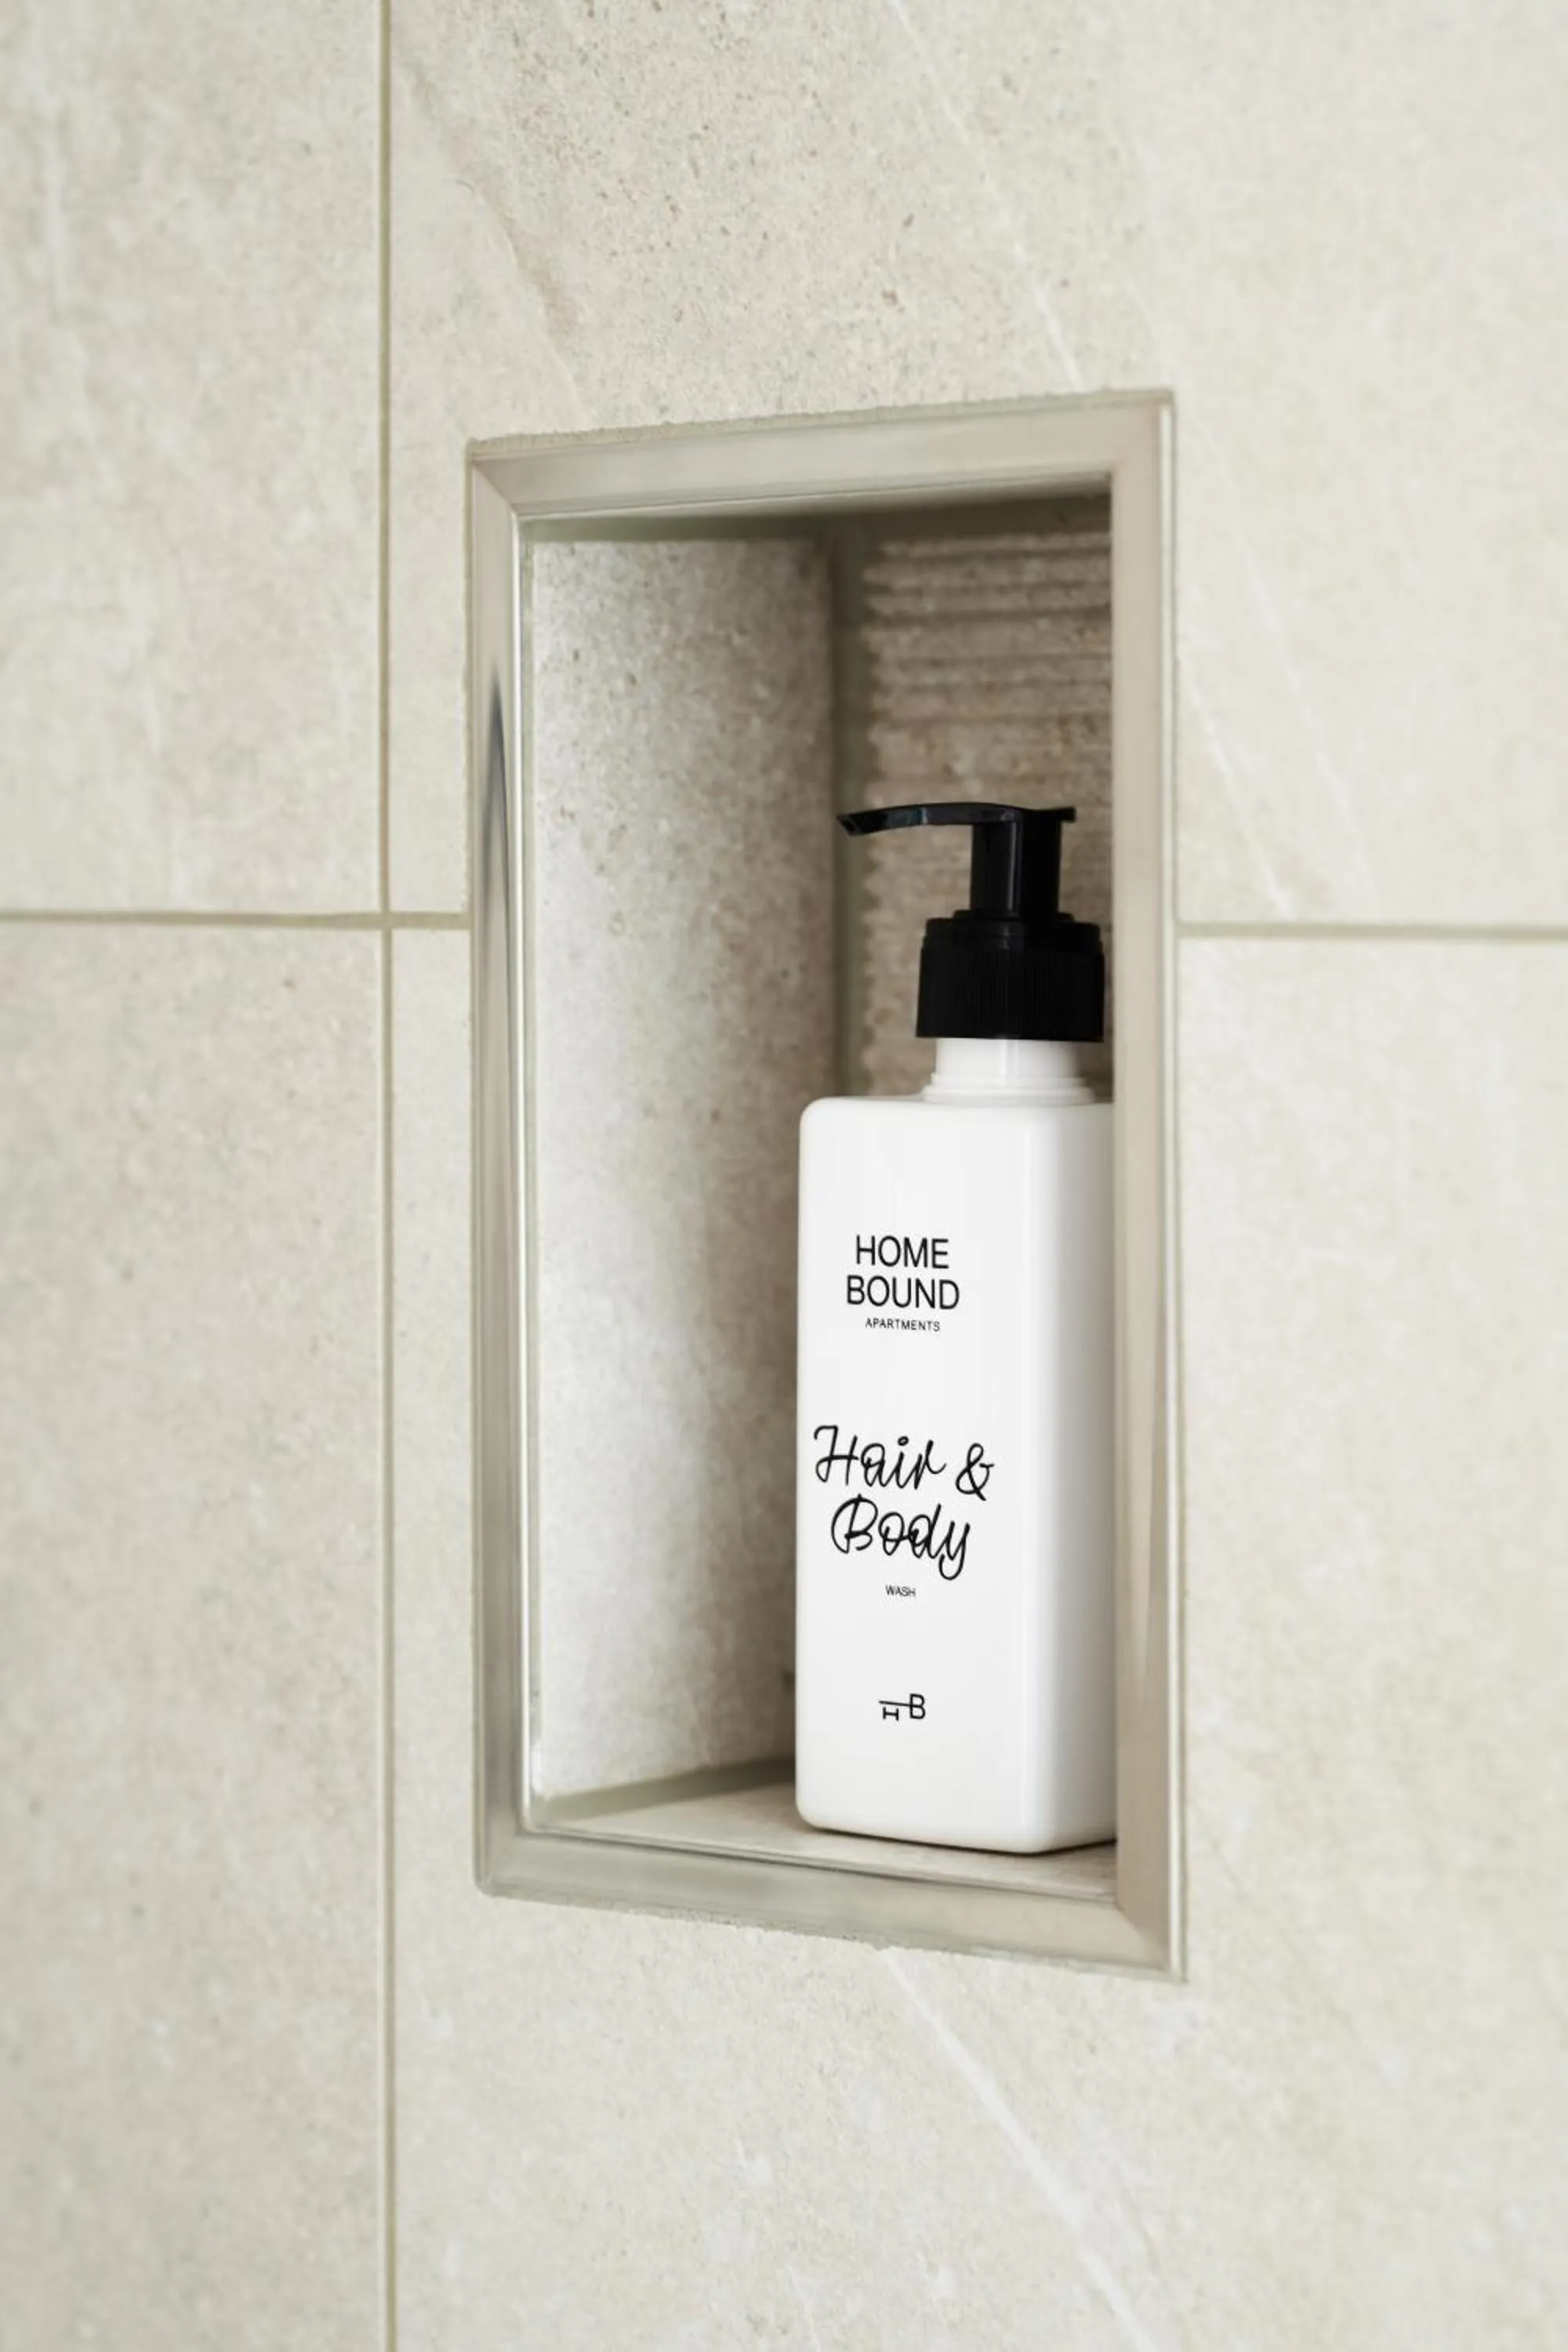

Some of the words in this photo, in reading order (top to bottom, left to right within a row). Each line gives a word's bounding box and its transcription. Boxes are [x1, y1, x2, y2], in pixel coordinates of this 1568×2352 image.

[855, 1234, 949, 1269] HOME
[846, 1274, 960, 1310] BOUND
[865, 1317, 941, 1332] APARTMENTS
[813, 1425, 947, 1490] Hair
[954, 1443, 995, 1501] &
[830, 1493, 971, 1581] Body
[885, 1584, 916, 1597] WASH
